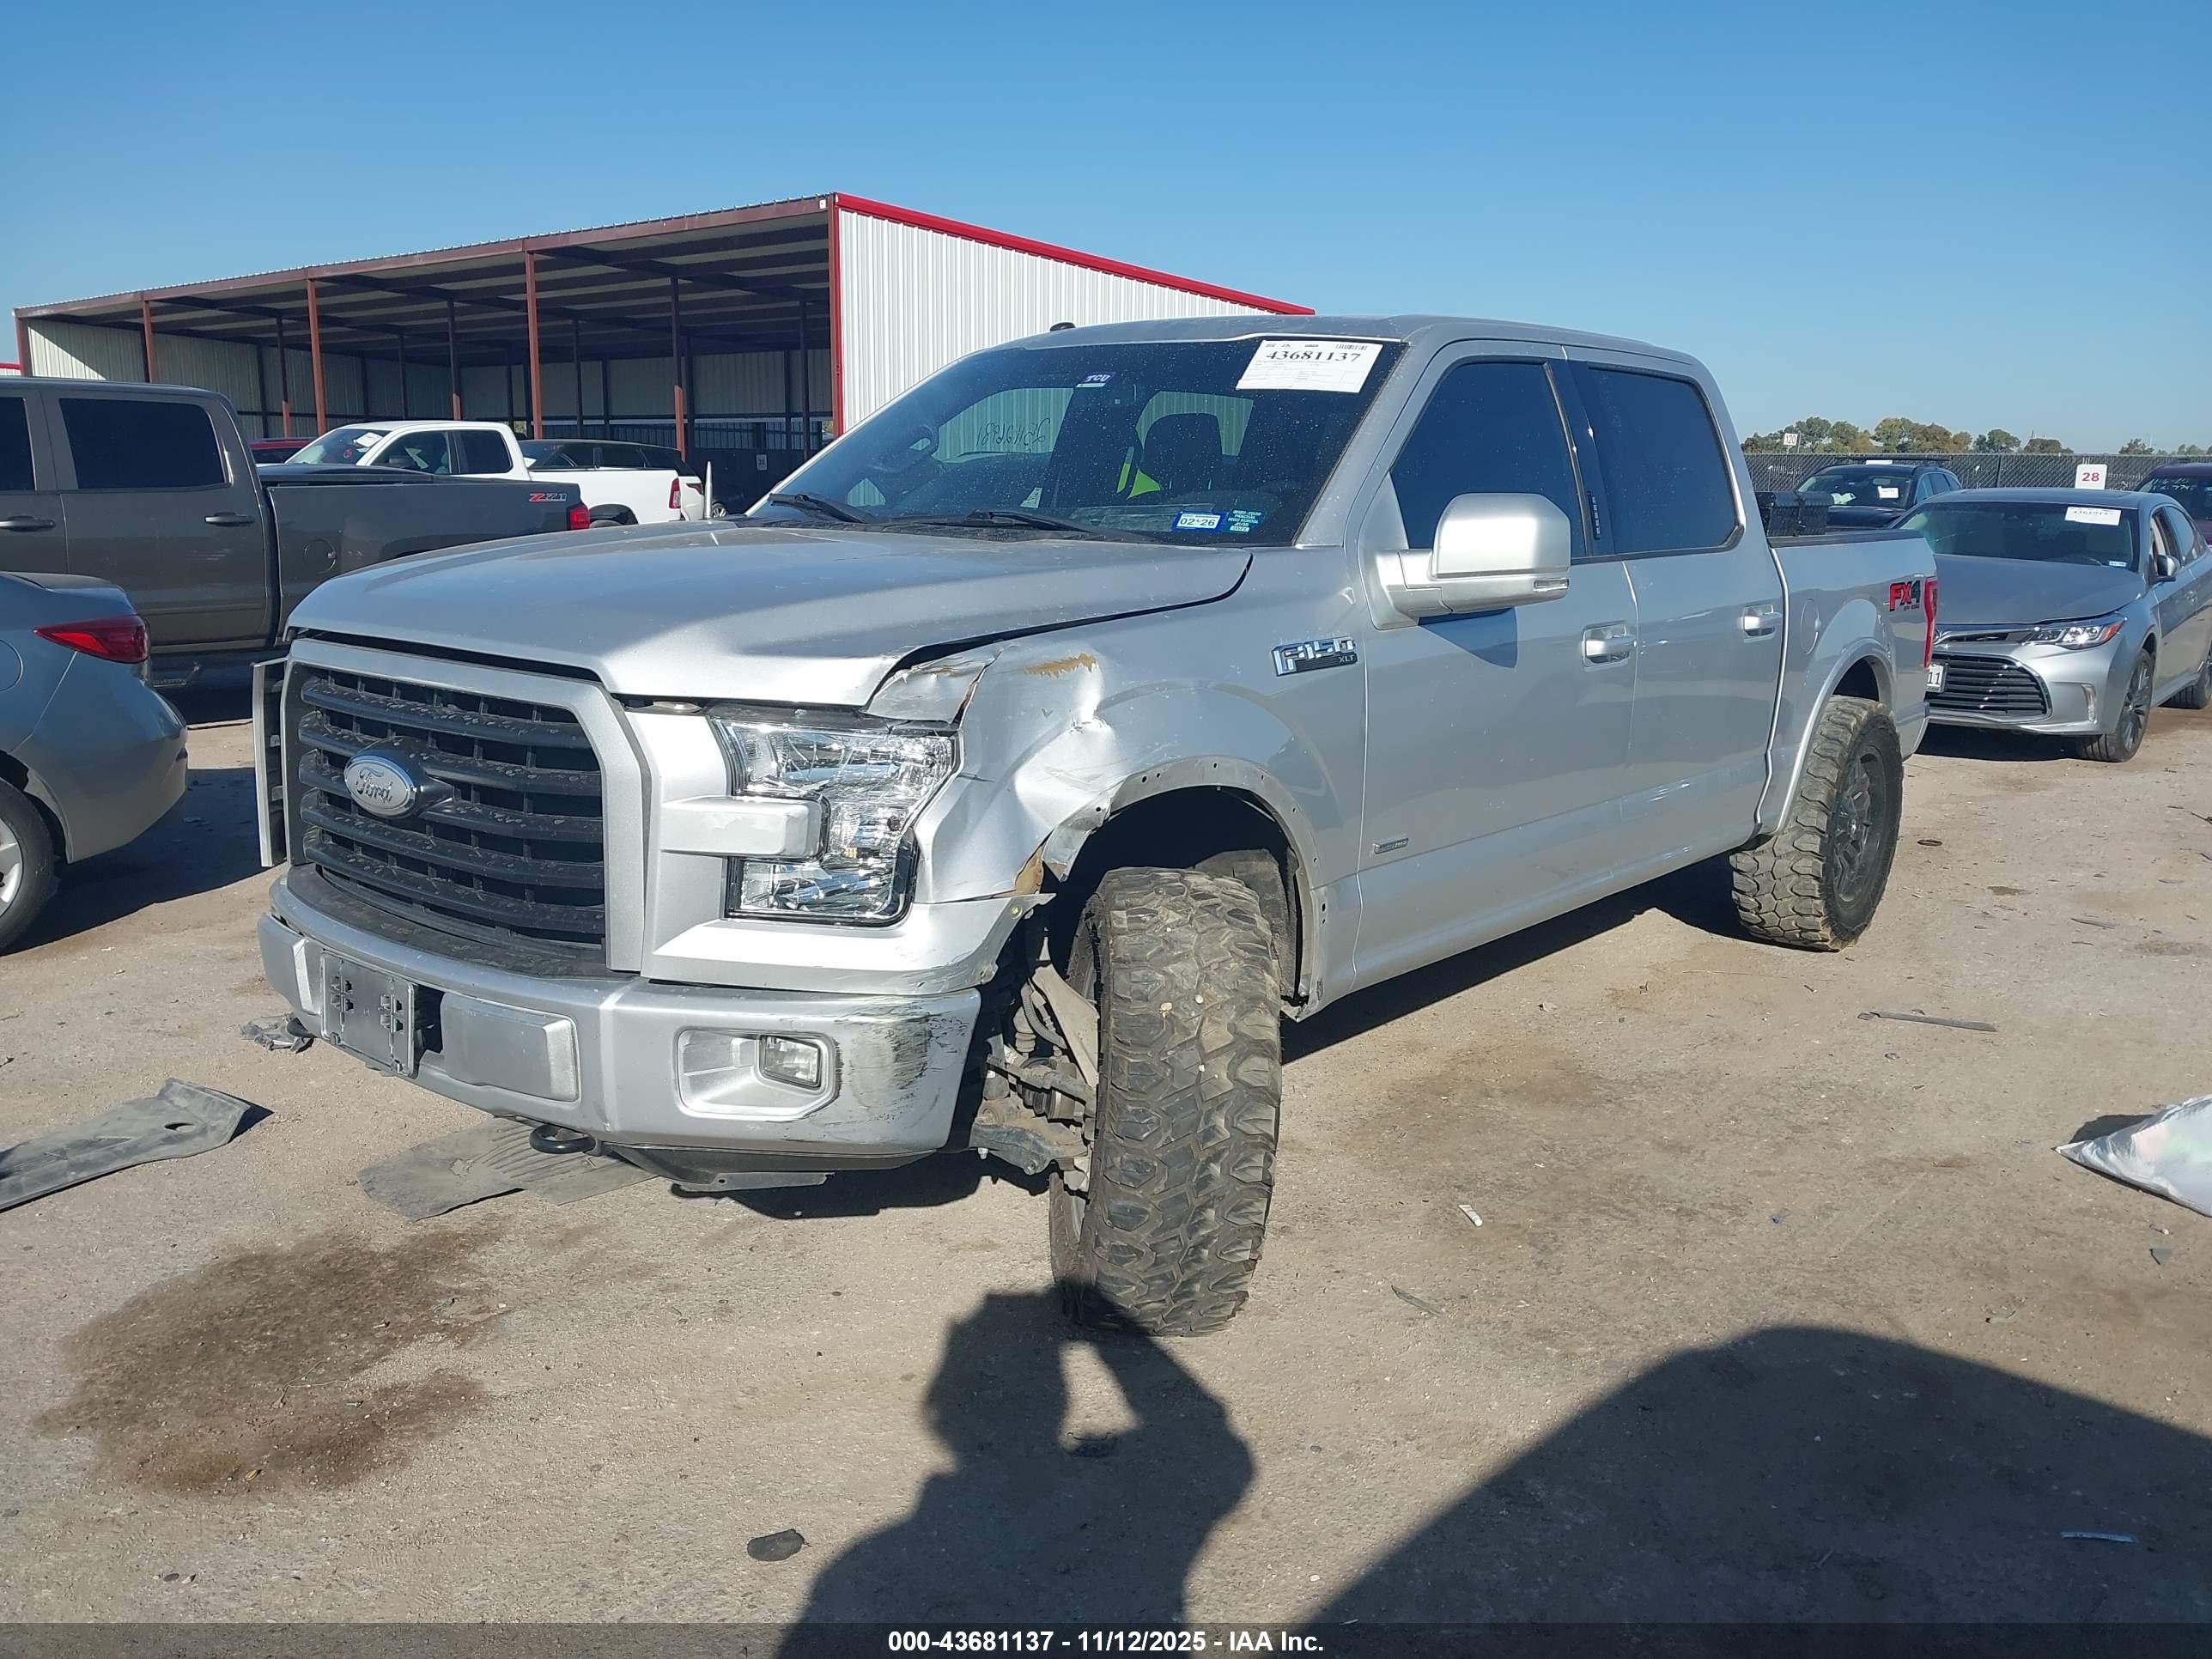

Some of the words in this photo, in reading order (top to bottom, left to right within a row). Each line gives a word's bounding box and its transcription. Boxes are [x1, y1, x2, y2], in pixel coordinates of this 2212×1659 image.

[1266, 350, 1361, 362] 43681137
[1085, 374, 1110, 383] TCU
[2081, 472, 2100, 482] 28
[529, 493, 567, 502] Z71
[1889, 580, 1921, 611] FX4
[1339, 654, 1355, 663] XLT
[356, 766, 393, 804] Ford
